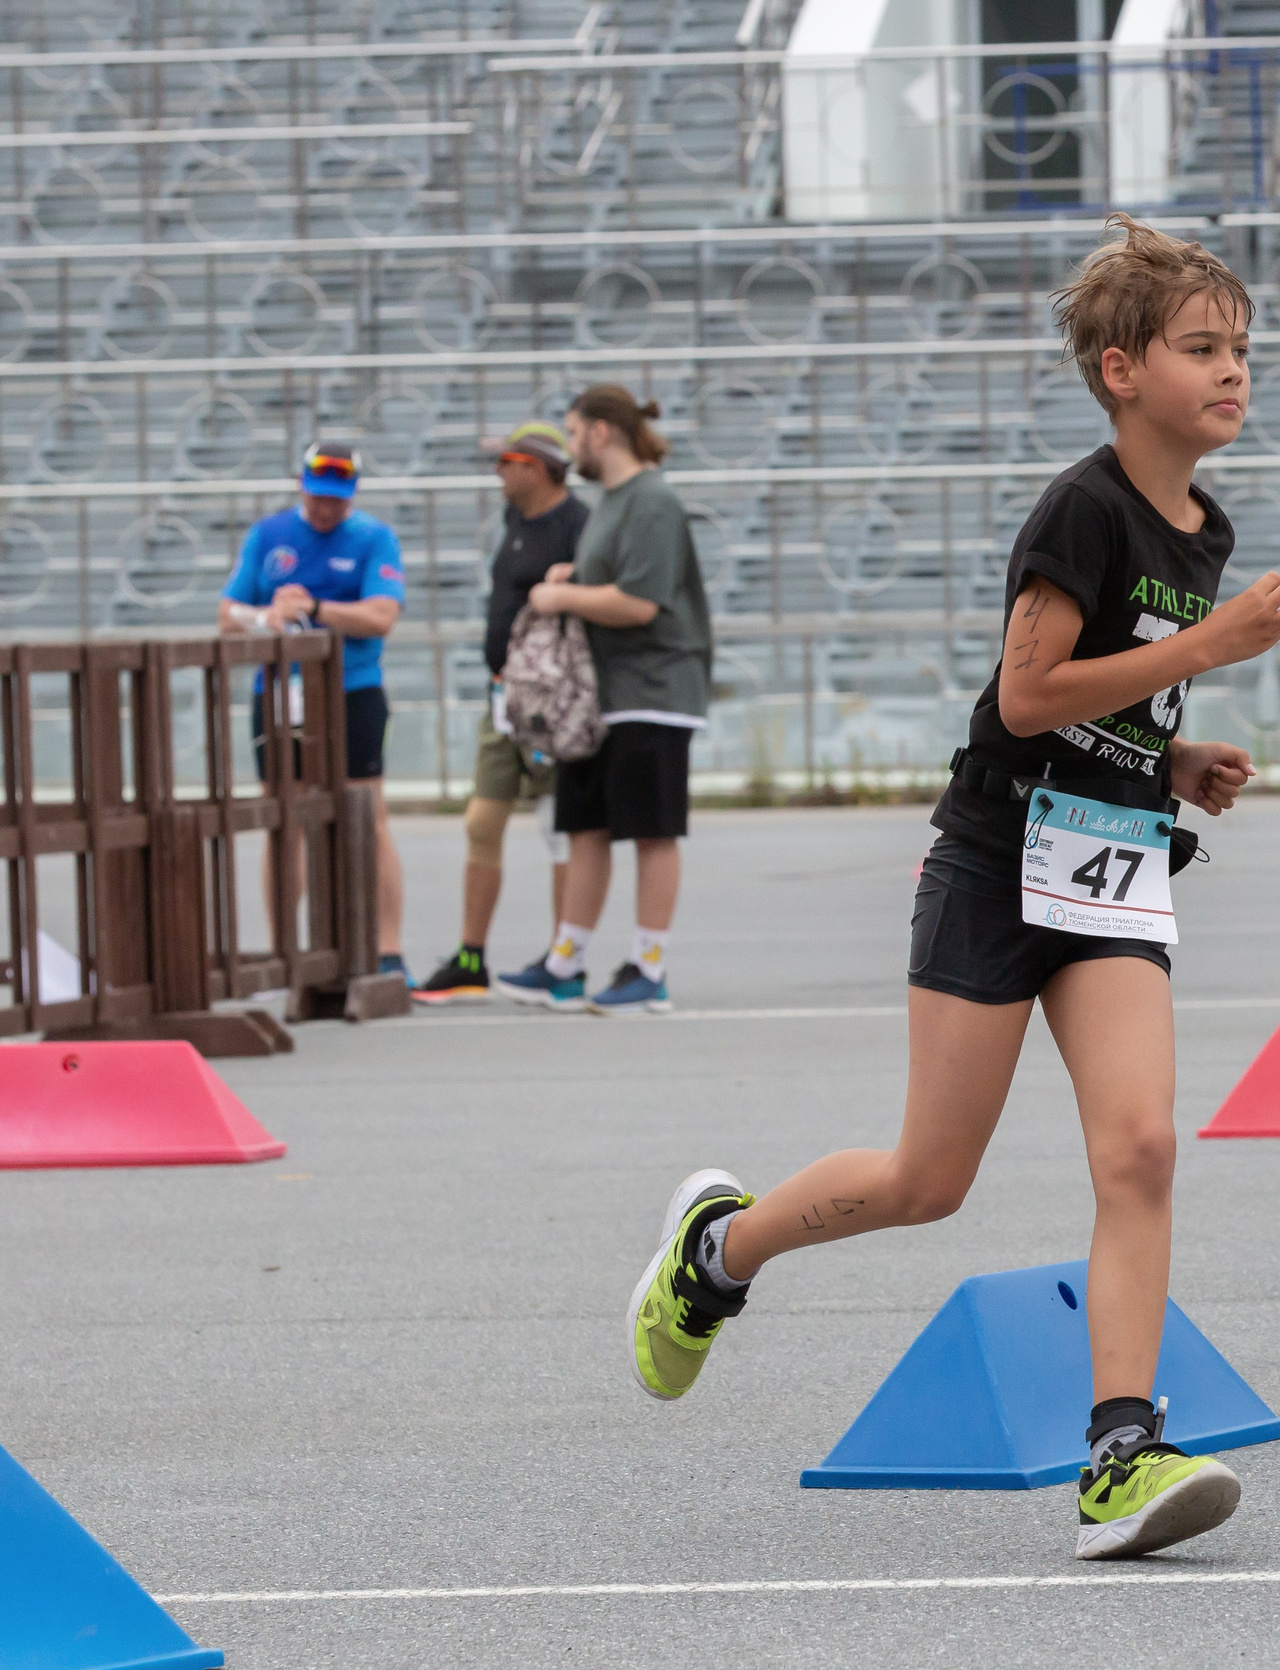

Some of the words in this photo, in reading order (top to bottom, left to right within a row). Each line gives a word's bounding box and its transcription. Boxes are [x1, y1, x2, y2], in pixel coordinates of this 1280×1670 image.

[1115, 723, 1143, 742] ON
[1059, 726, 1091, 746] RST
[1096, 743, 1139, 769] RUN
[1026, 858, 1049, 868] МОТОРС
[1071, 846, 1145, 901] 47
[1068, 911, 1110, 923] ФЕДЕРАЦИЯ
[1111, 917, 1154, 928] ТРИАТЛОНА
[1068, 918, 1111, 930] ТЮМЕНСКОЙ
[1112, 924, 1146, 932] ОБЛАСТИ
